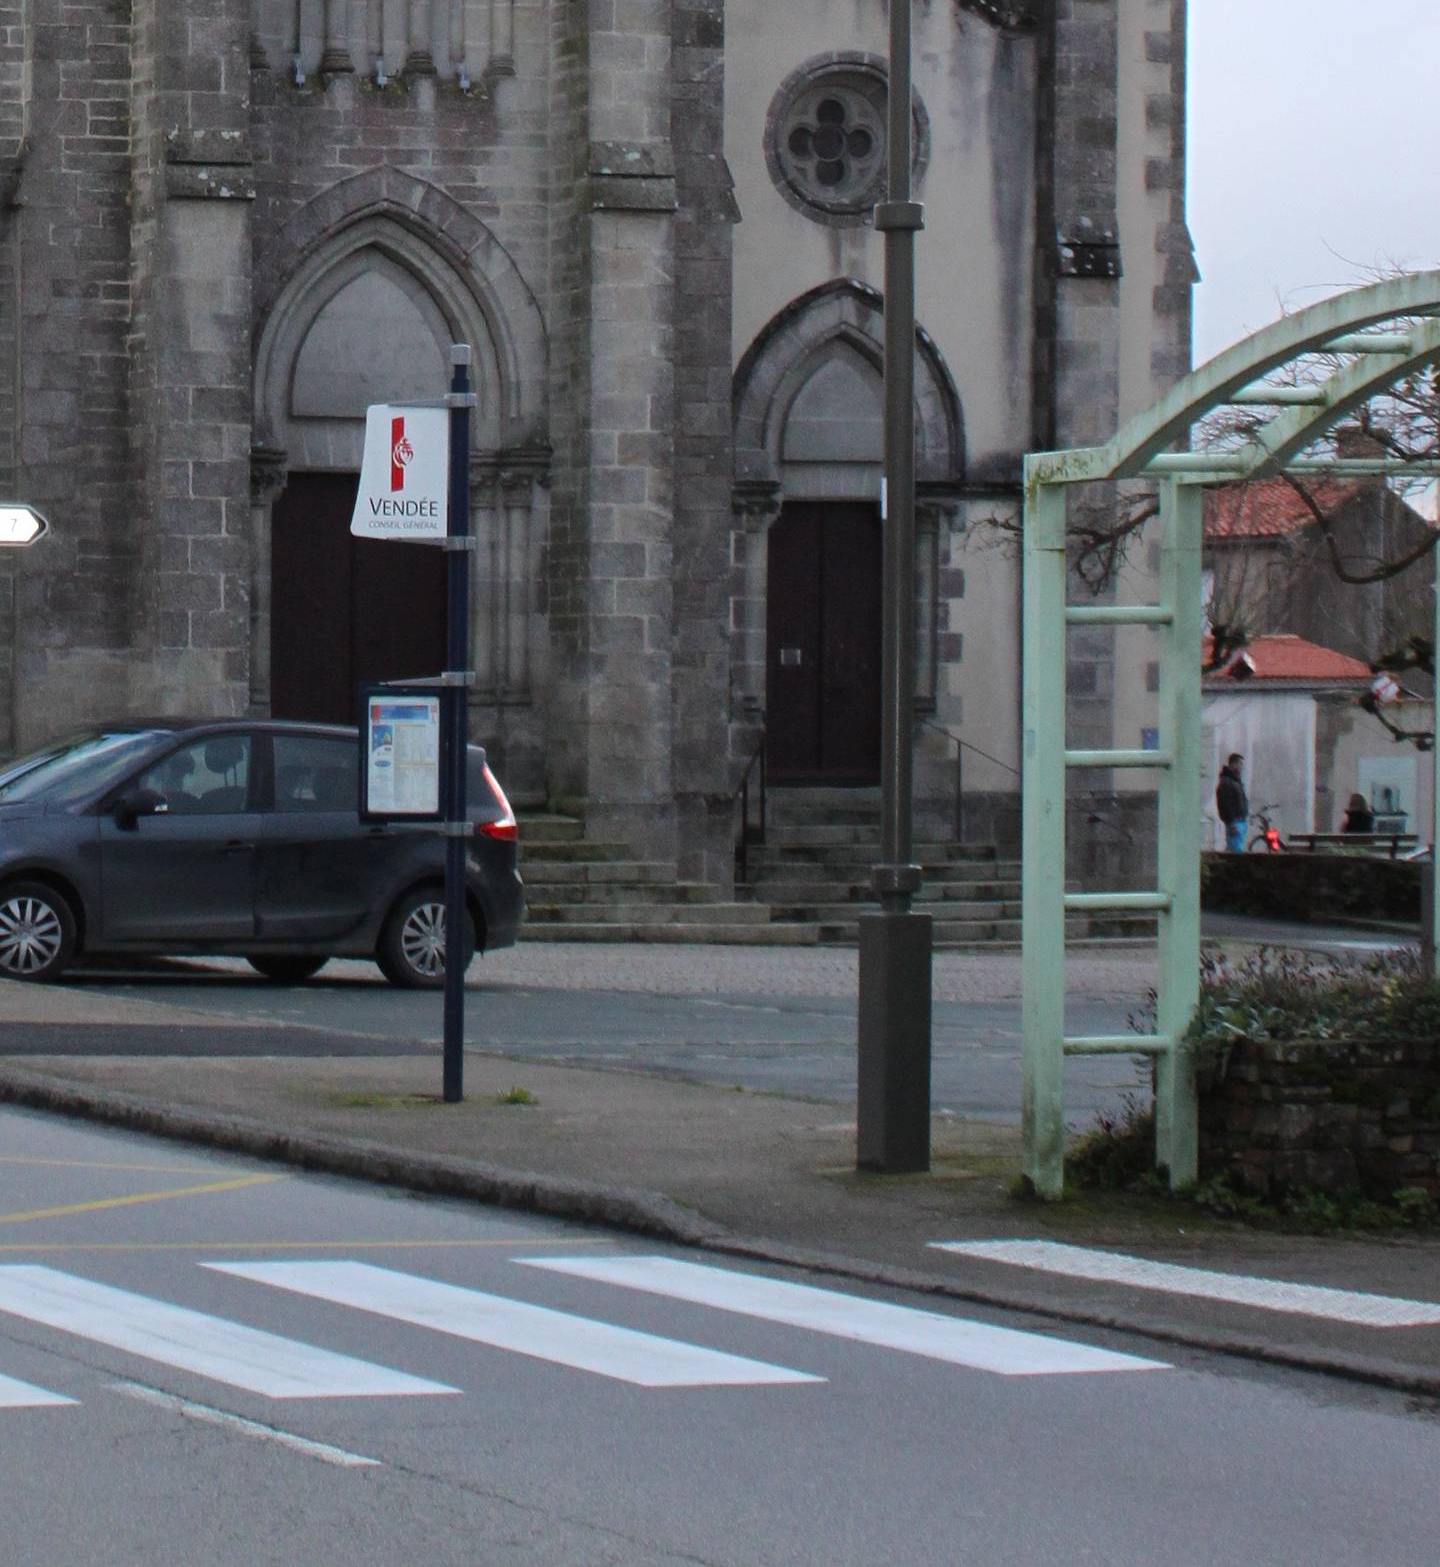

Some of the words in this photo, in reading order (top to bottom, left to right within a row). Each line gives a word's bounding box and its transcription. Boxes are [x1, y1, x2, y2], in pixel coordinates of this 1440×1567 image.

[369, 497, 438, 517] VENDÉE
[10, 518, 18, 533] 7
[368, 520, 400, 529] CONSEIL
